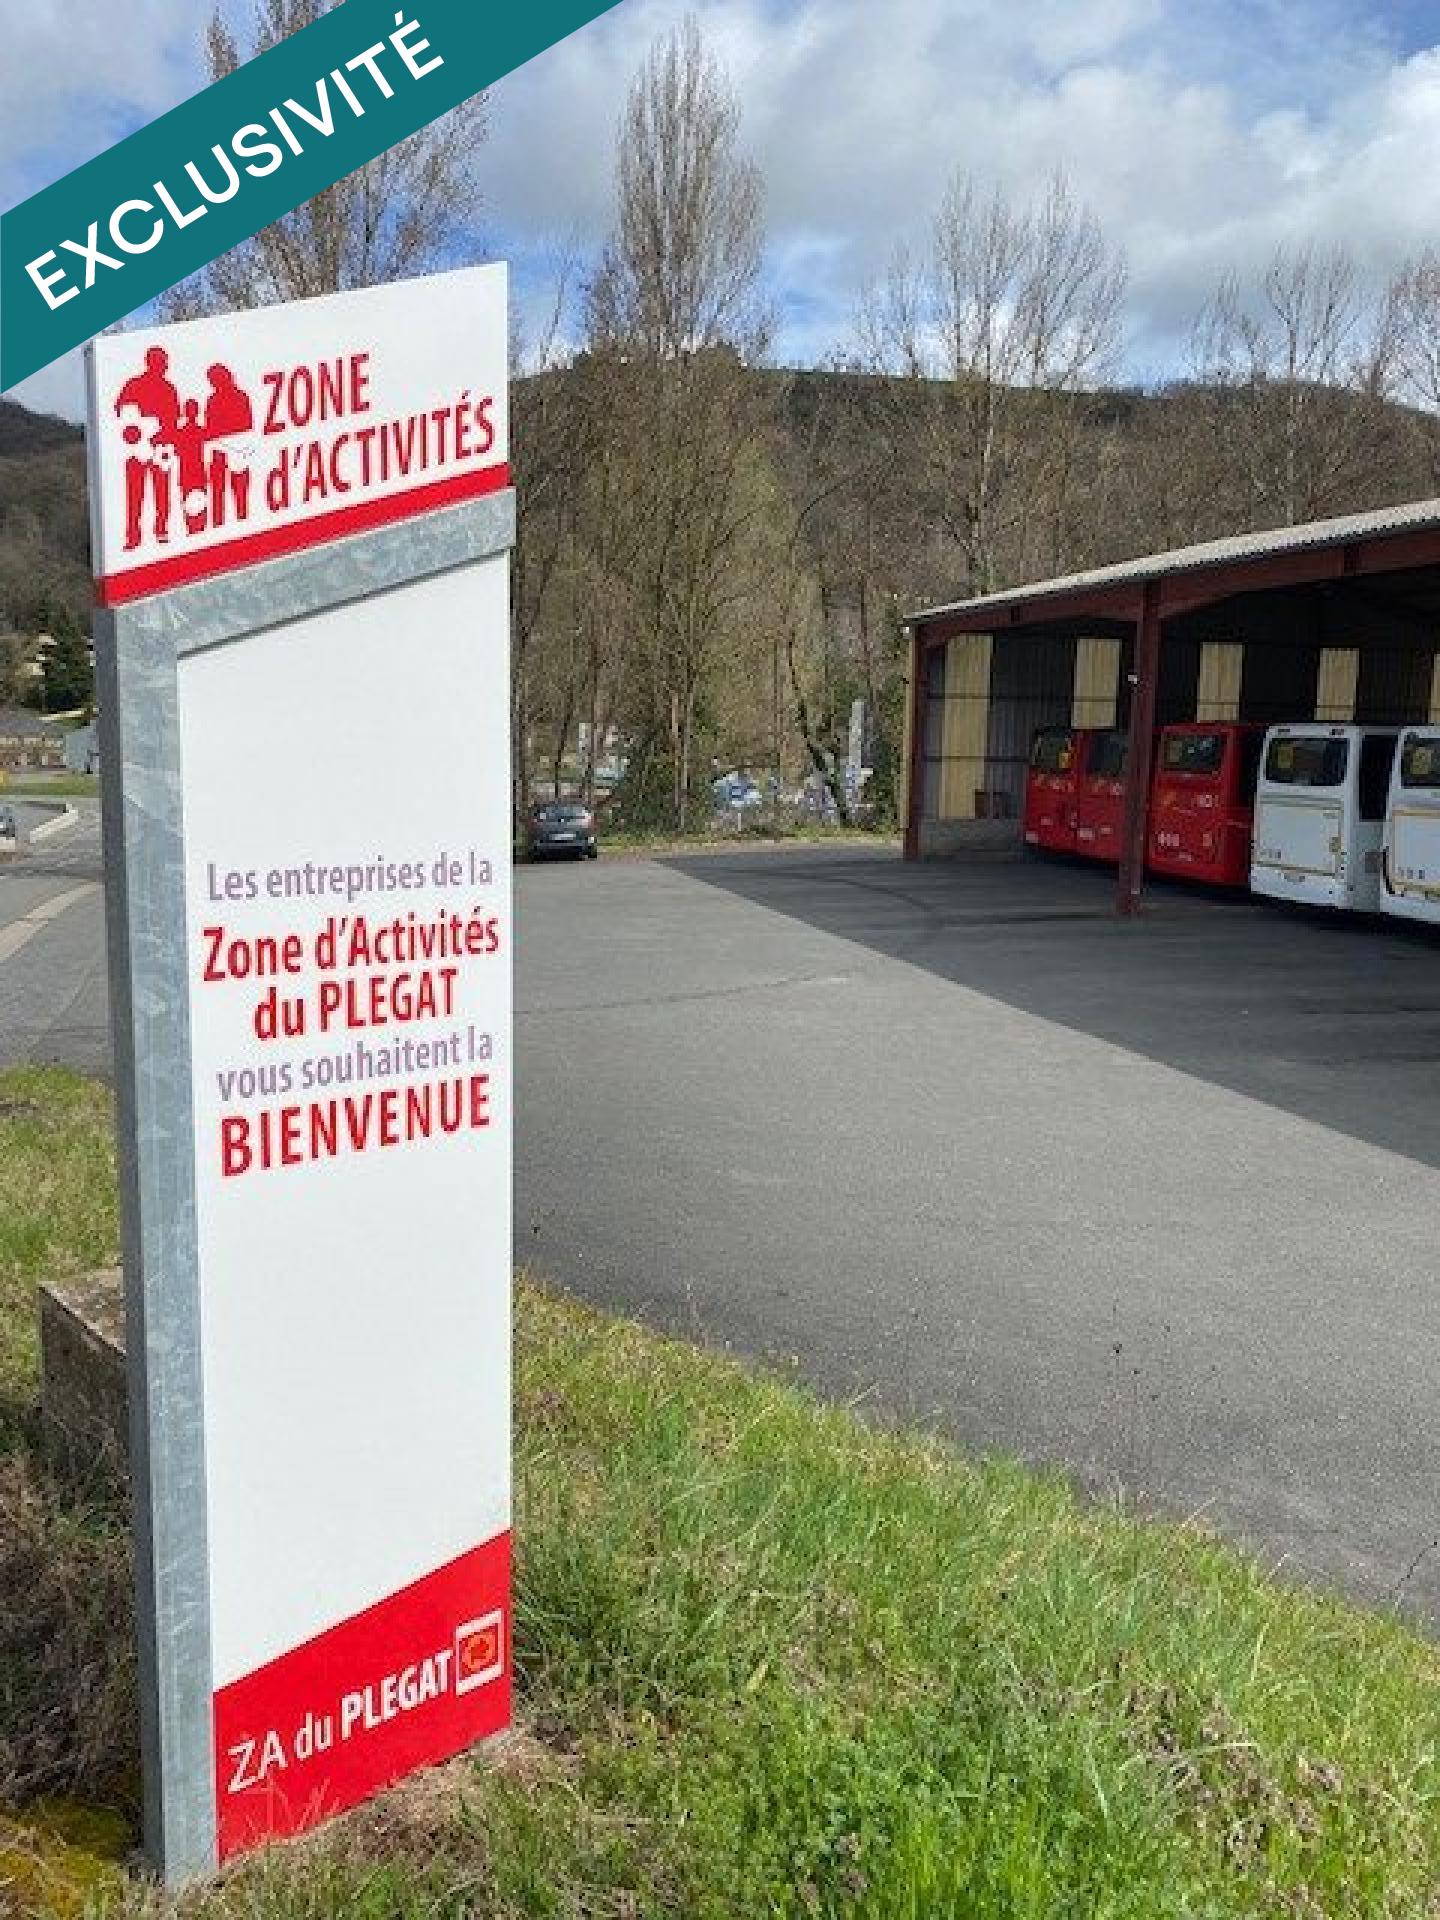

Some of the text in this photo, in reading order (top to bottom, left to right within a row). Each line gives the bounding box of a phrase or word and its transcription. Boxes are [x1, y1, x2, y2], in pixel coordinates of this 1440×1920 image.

[263, 354, 370, 435] ZONE
[207, 852, 493, 902] Les entreprises de la
[203, 926, 303, 981] Zone
[254, 968, 458, 1040] du PLEGAT
[216, 1025, 493, 1101] vous souhaitent la
[221, 1074, 490, 1177] BIENVENUE
[227, 1649, 452, 1794] ZA du PLEGAT
